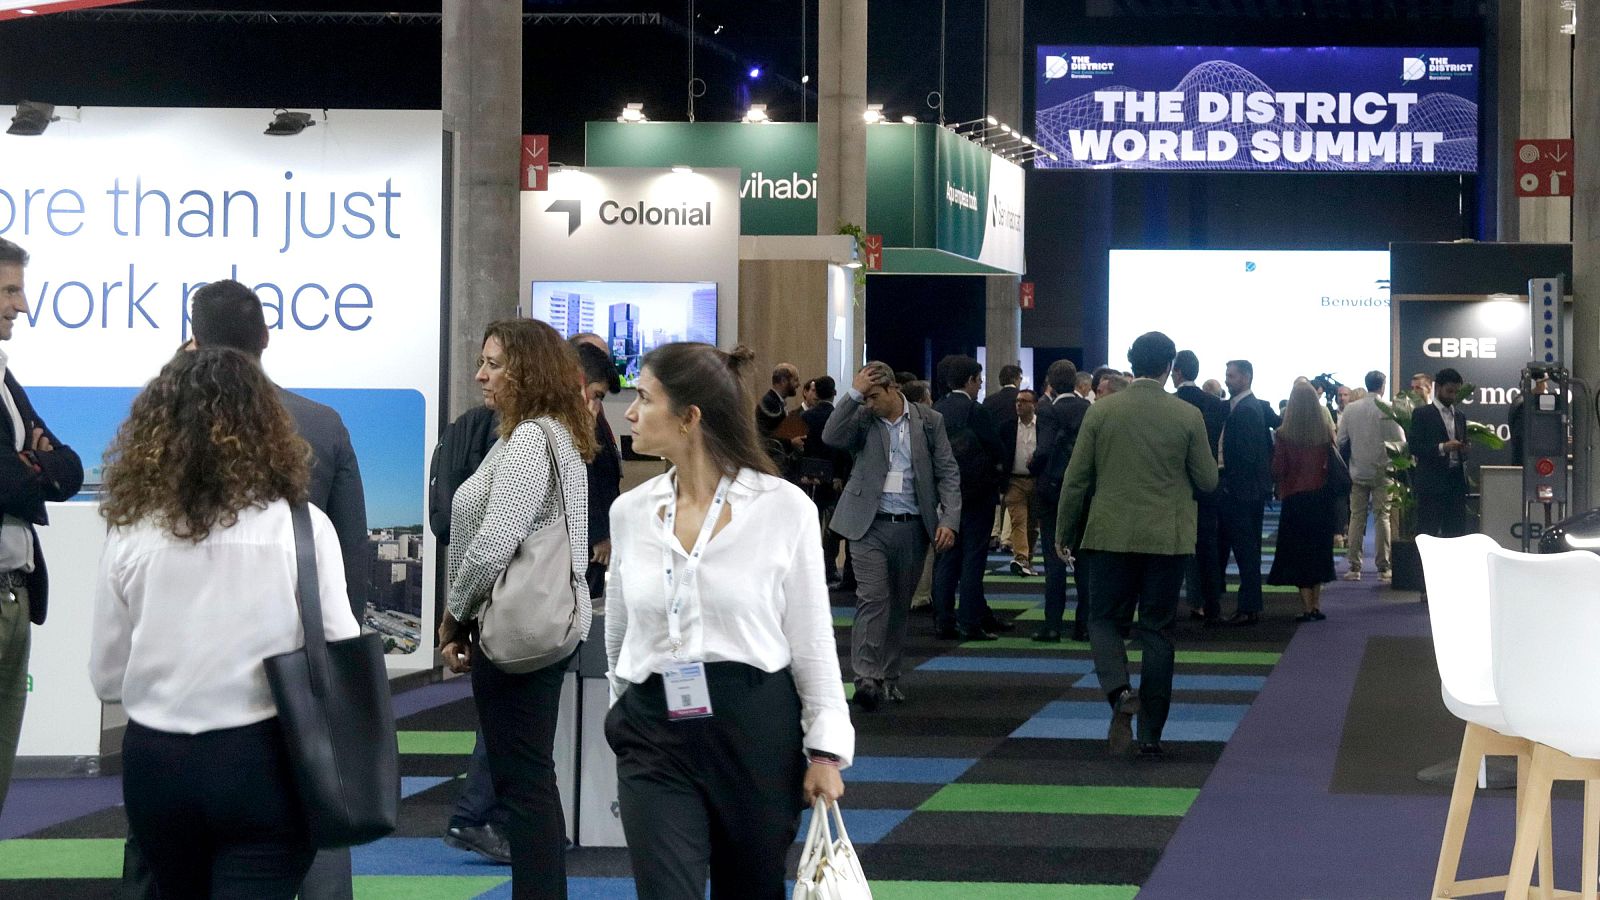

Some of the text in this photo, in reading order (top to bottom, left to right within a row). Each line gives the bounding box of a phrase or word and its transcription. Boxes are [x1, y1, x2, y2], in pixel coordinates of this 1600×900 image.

[1071, 56, 1090, 64] THE
[1429, 64, 1473, 72] DISTRICT
[1095, 91, 1417, 124] THE DISTRICT
[1069, 129, 1443, 163] WORLD SUMMIT
[106, 174, 258, 238] than
[280, 171, 401, 253] just
[599, 200, 711, 226] Colonial
[181, 264, 373, 343] pace
[1422, 337, 1497, 359] CBRE
